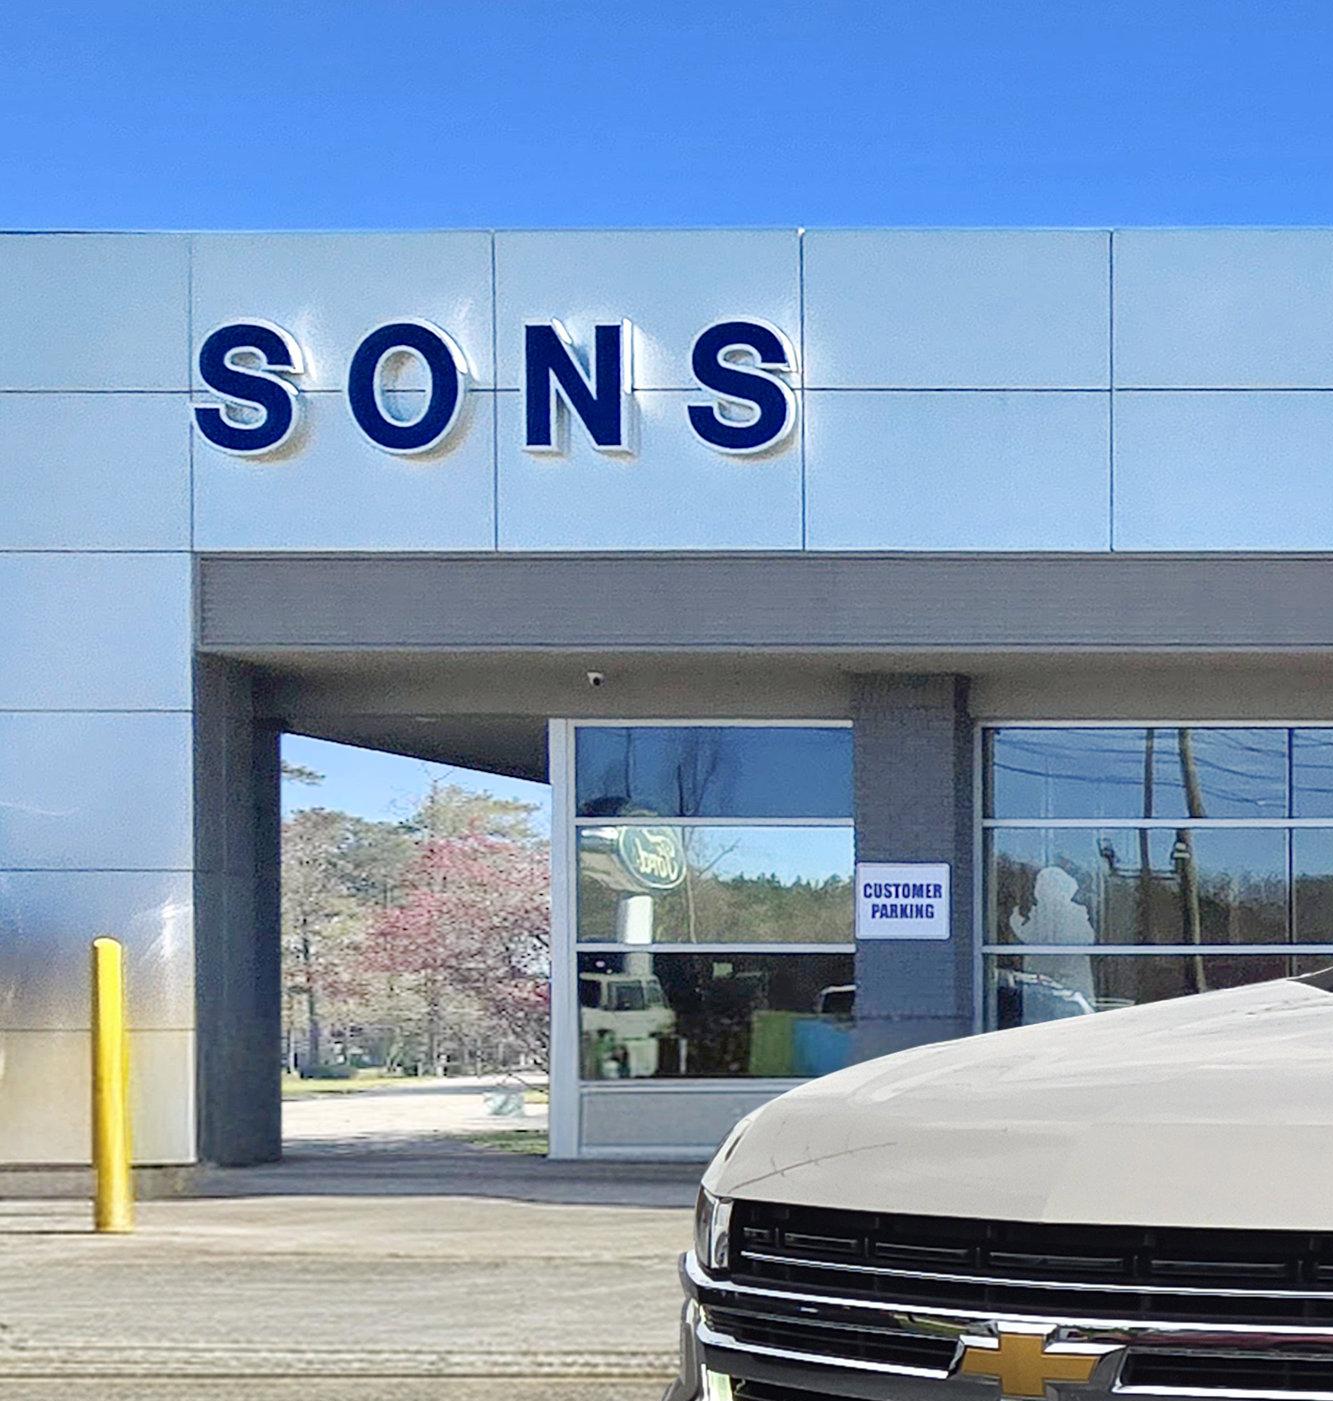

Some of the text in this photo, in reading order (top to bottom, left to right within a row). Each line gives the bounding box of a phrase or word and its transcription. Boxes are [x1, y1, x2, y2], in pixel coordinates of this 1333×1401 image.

[191, 317, 798, 456] SONS
[863, 883, 943, 899] CUSTOMER
[871, 903, 935, 919] PARKING
